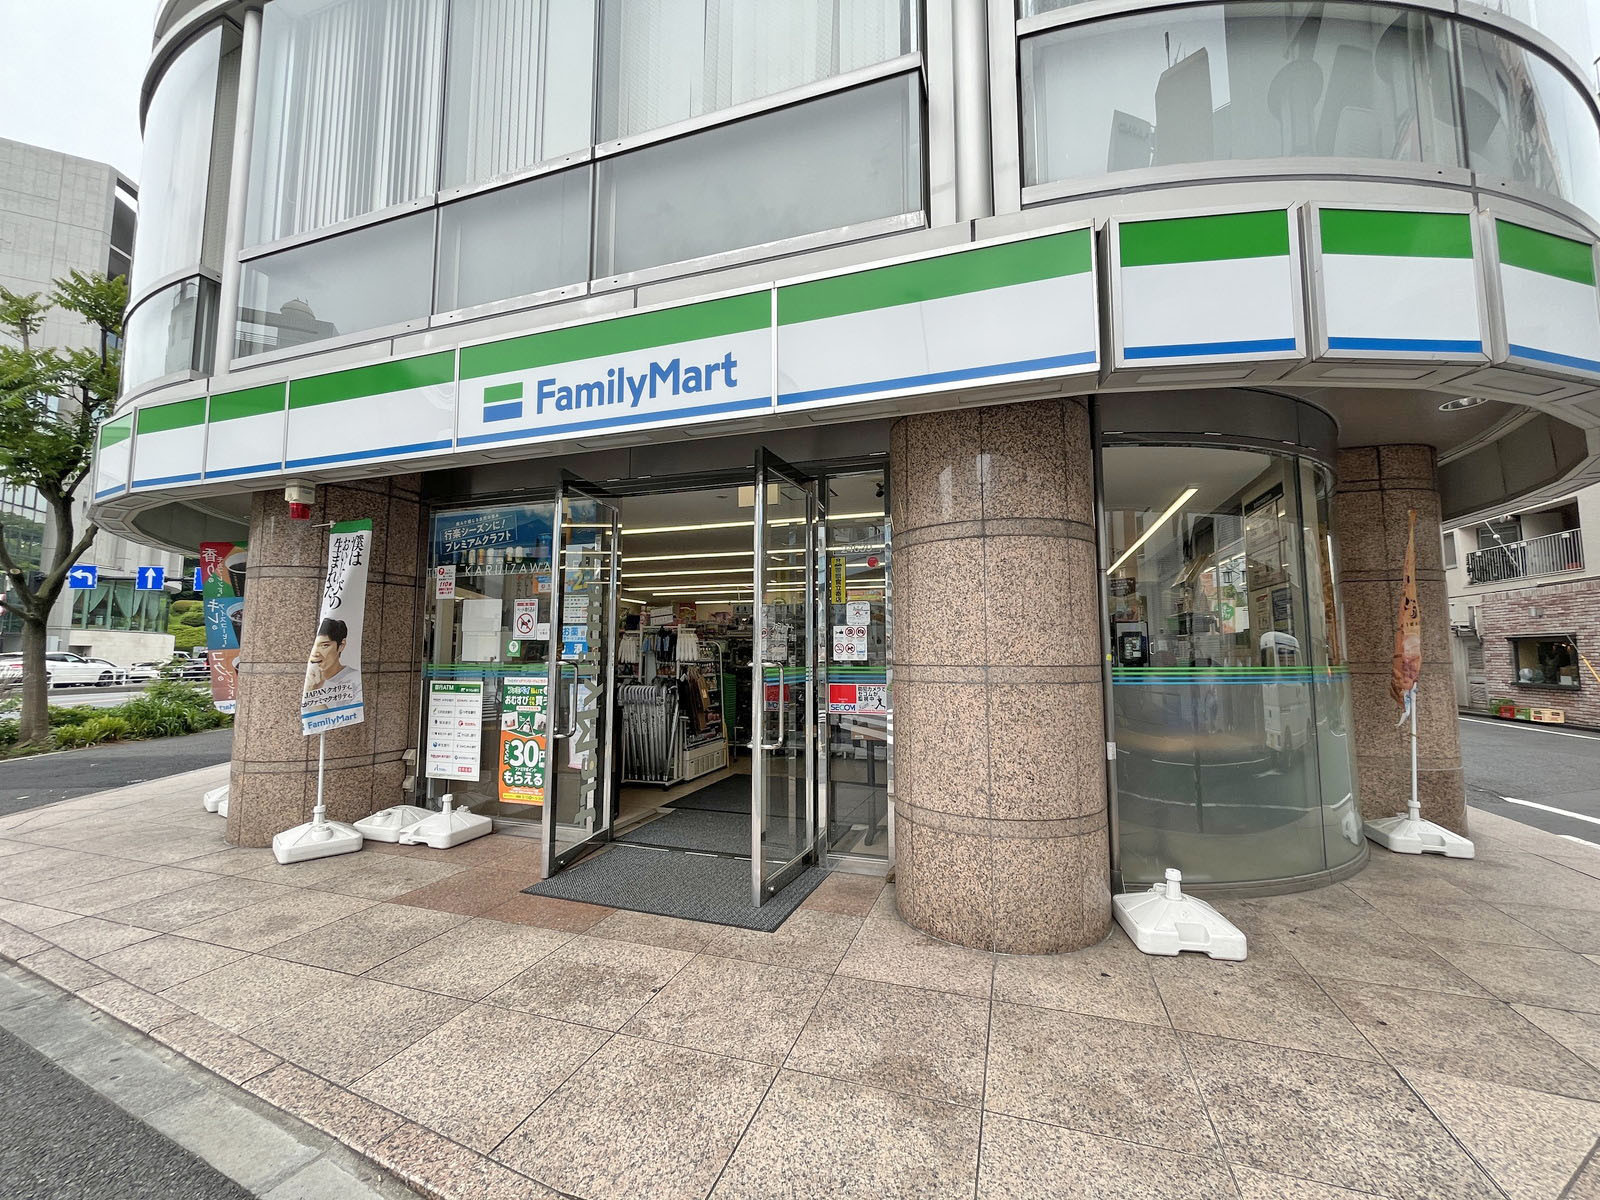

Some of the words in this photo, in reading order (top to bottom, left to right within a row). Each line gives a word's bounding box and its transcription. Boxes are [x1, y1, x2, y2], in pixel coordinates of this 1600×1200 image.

[536, 351, 738, 415] FamilyMart
[444, 519, 506, 541] 行楽シーズンに!
[349, 535, 365, 566] 僕は
[445, 531, 512, 552] プレミアムクラフト
[304, 685, 353, 699] JAPANクオリティ
[830, 703, 856, 712] SECOM
[307, 712, 357, 729] FamilyMart
[503, 770, 543, 786] もらえる
